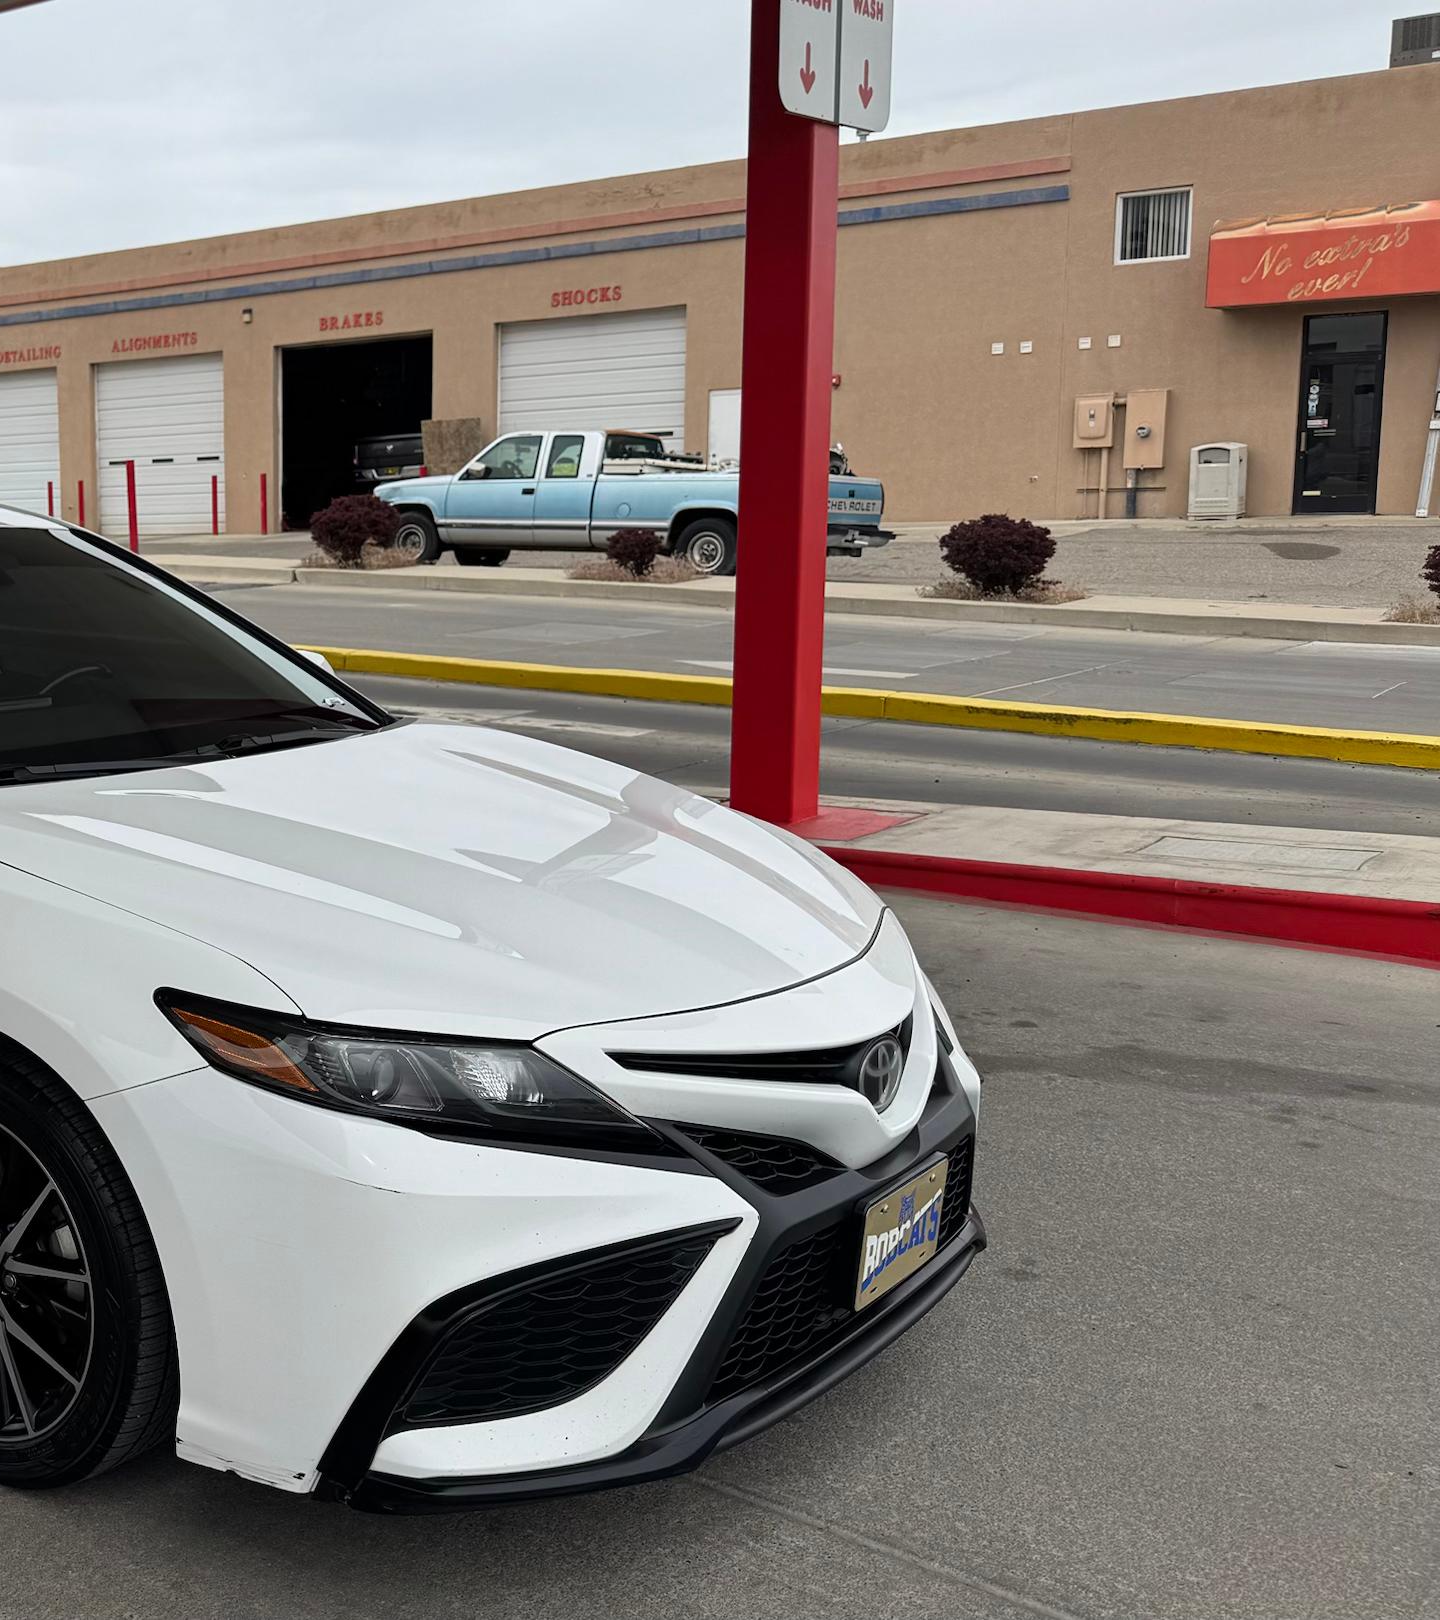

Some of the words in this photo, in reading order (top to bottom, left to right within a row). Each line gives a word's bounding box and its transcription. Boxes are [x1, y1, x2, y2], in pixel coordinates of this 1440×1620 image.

[852, 0, 884, 22] WASH
[1241, 243, 1293, 284] No
[1303, 222, 1411, 270] extra's
[1287, 257, 1373, 301] ever!
[551, 285, 622, 307] SHOCKS
[319, 311, 384, 331] BRAKES
[112, 332, 198, 353] ALIGNMENTS
[860, 1188, 944, 1293] BOBCATS
